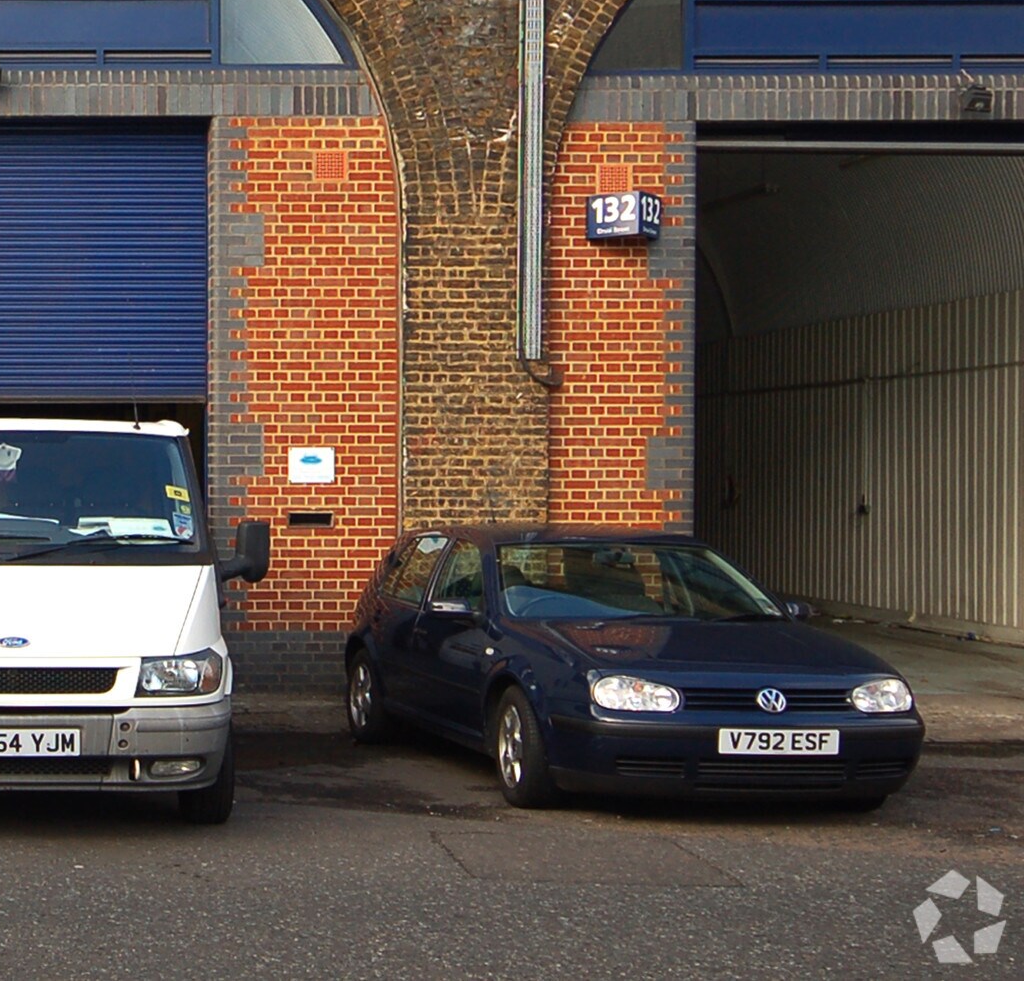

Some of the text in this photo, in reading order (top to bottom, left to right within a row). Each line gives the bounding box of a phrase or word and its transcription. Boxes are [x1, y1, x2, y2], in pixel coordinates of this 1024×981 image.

[591, 194, 636, 224] 132
[641, 195, 660, 225] 132
[31, 733, 75, 753] YJM
[730, 731, 831, 751] V792 ESF
